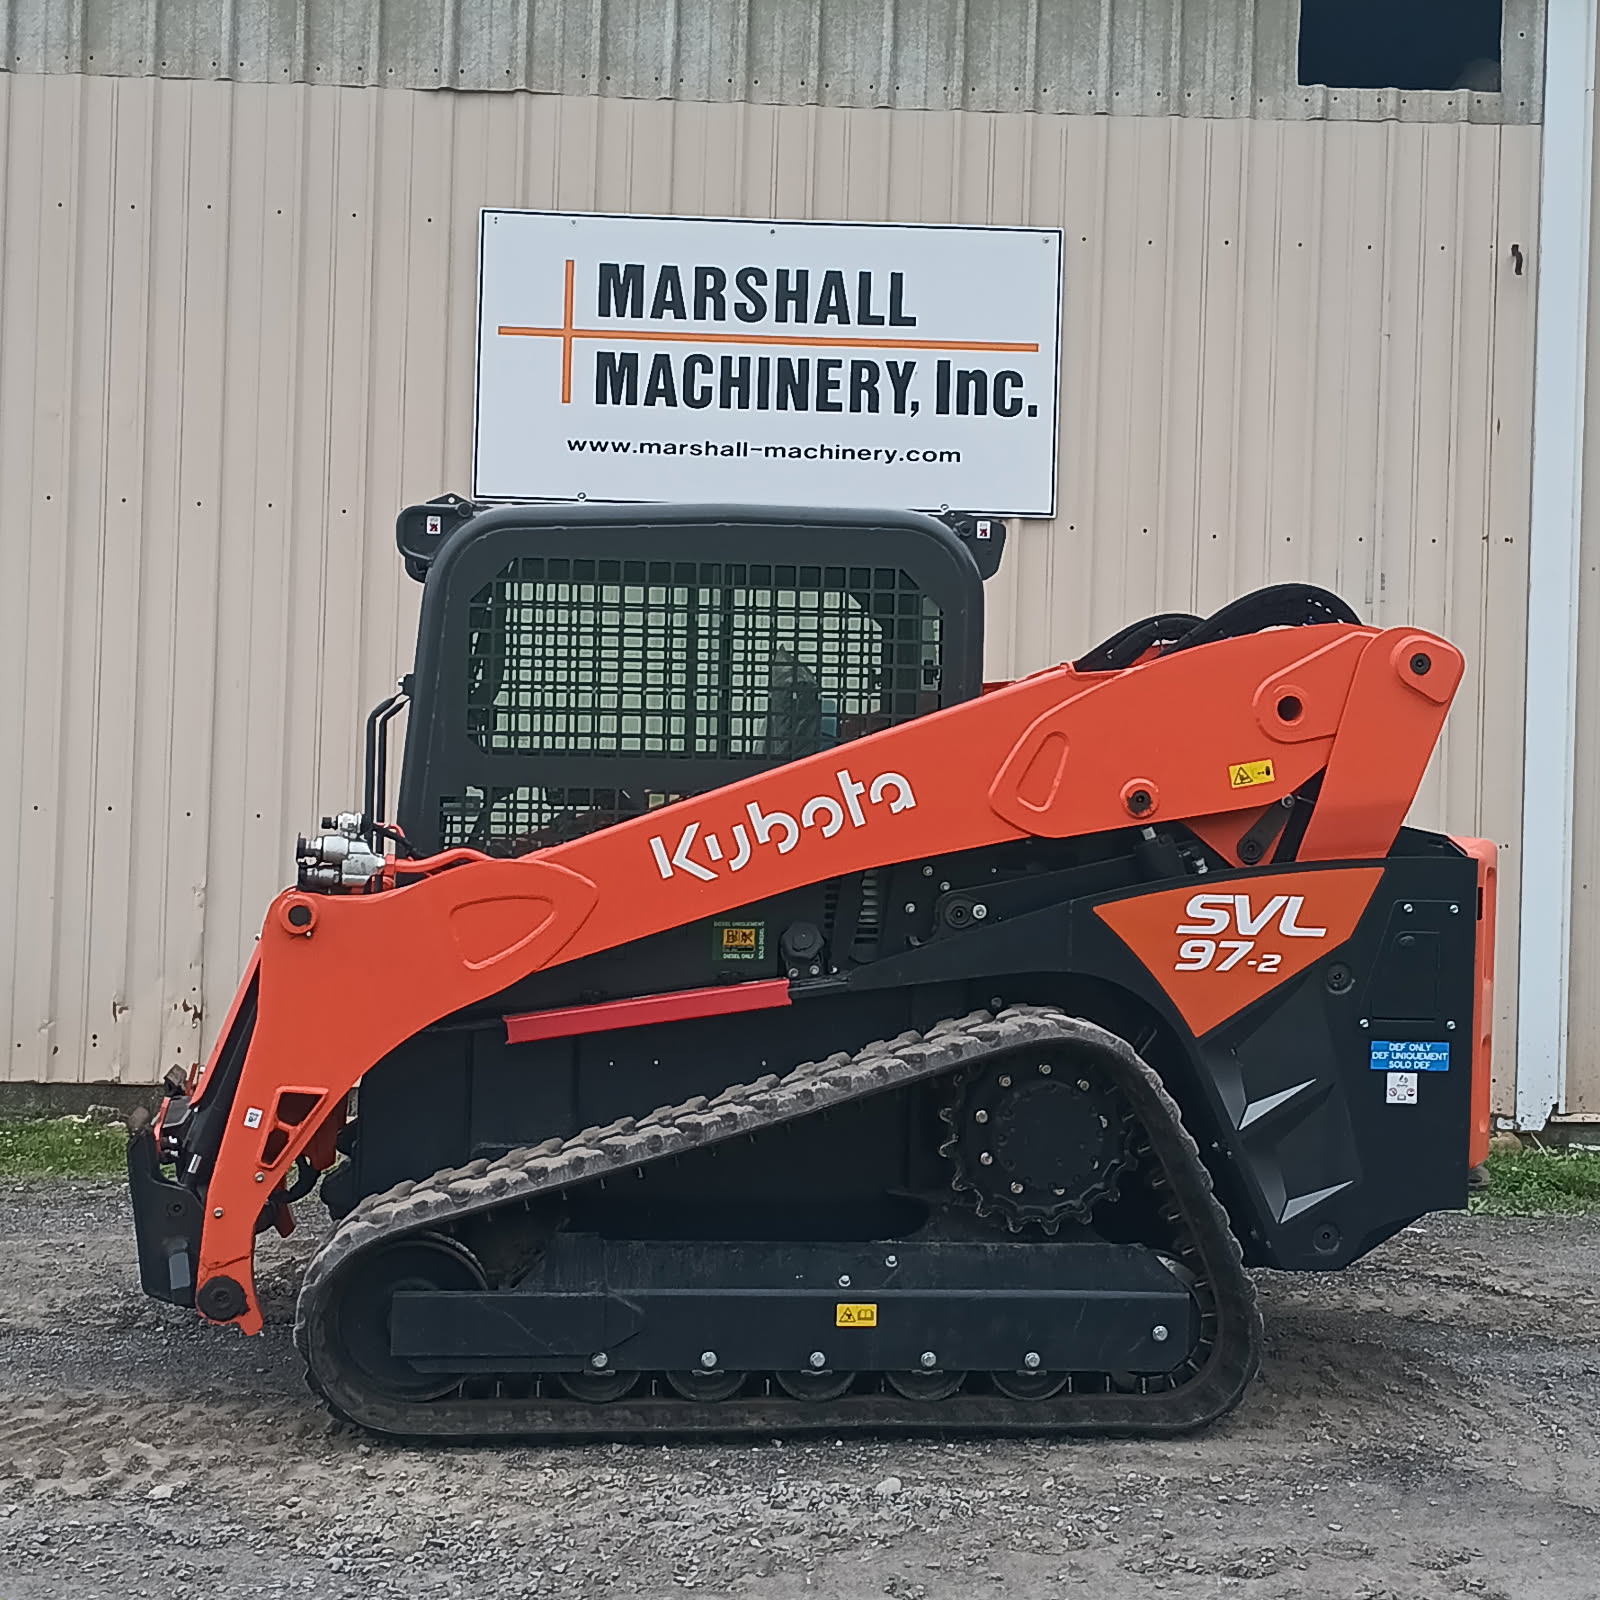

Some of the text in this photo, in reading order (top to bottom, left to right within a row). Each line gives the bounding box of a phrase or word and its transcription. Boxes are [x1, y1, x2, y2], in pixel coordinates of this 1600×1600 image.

[598, 263, 917, 327] MARSHALL
[595, 351, 1038, 418] MACHINERY, Inc.
[567, 438, 962, 465] www.marshall-machinery.com
[650, 769, 917, 881] Kubota
[1176, 894, 1327, 937] SVL
[1175, 939, 1282, 973] 97-2
[1372, 1051, 1449, 1060] DEF UNIQUEMENT
[1388, 1042, 1432, 1052] DEF ONLY
[1388, 1060, 1431, 1069] SOLO DEF
